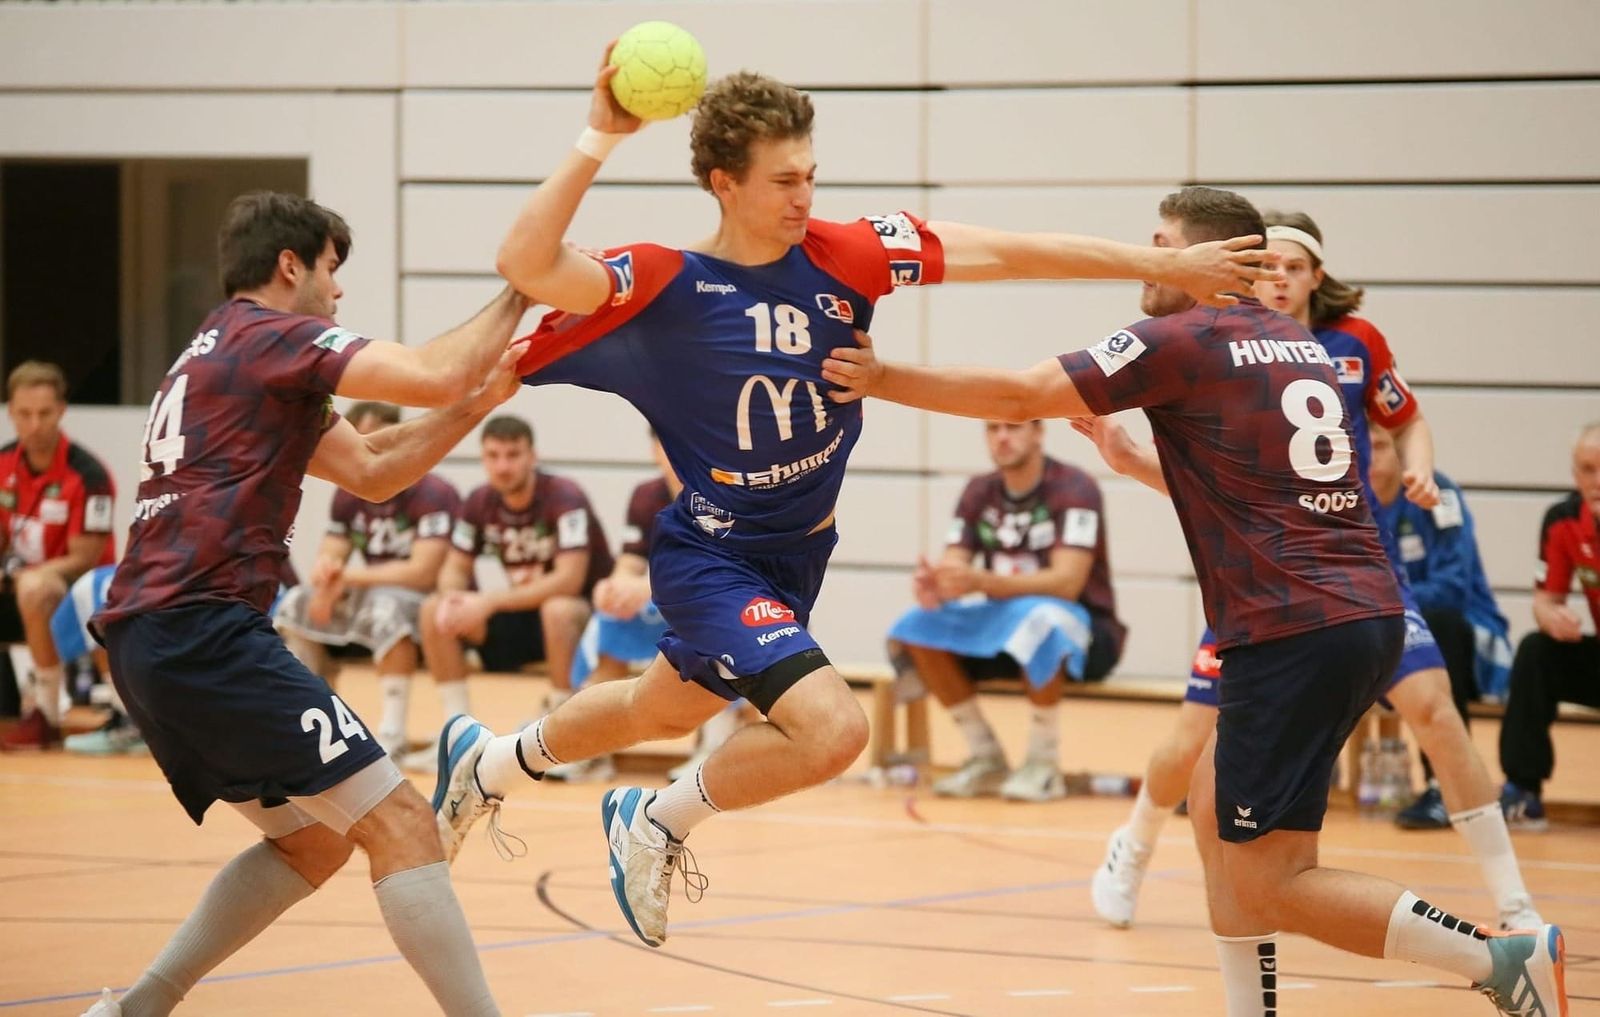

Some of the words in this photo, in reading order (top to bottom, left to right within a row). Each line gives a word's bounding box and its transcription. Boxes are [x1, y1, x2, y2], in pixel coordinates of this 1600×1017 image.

[696, 280, 737, 296] Kempa
[745, 302, 812, 355] 18
[140, 373, 186, 482] 4
[1281, 378, 1352, 482] 8
[1298, 491, 1358, 514] SOOS
[756, 626, 801, 646] Kempa
[300, 695, 368, 764] 24
[1234, 818, 1257, 829] erima
